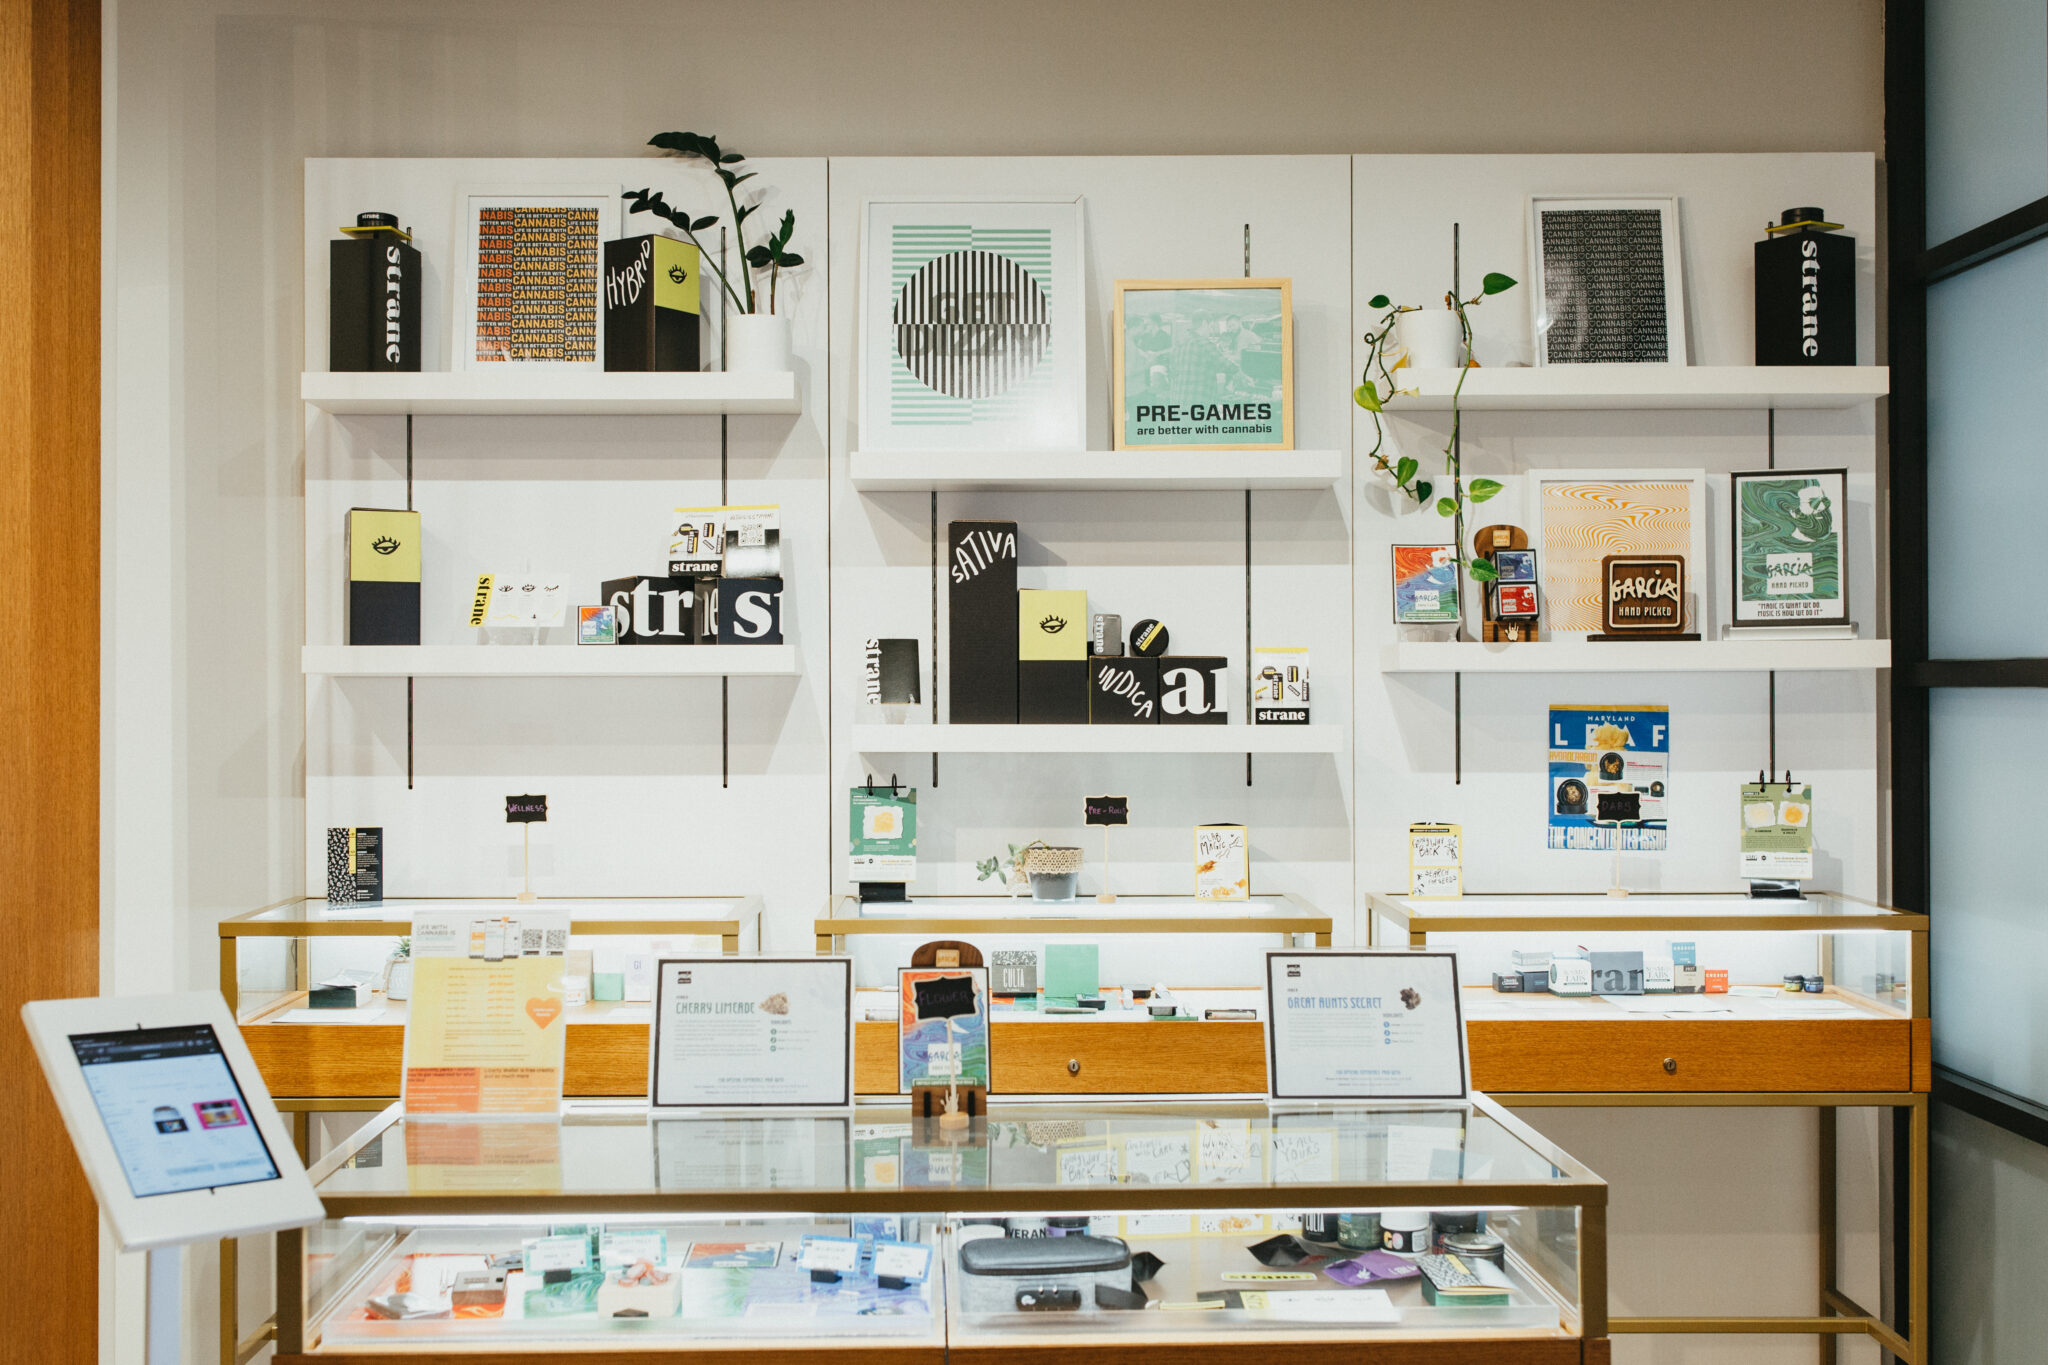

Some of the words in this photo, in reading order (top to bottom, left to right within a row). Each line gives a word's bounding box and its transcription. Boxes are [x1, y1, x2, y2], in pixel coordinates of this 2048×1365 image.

[514, 219, 566, 227] CANNABIS
[514, 233, 566, 242] CANNABIS
[513, 248, 566, 256] CANNABIS
[513, 262, 565, 270] CANNABIS
[513, 276, 565, 285] CANNABIS
[606, 240, 650, 310] HYBRID
[512, 291, 565, 299] CANNABIS
[1802, 240, 1820, 356] strane
[386, 246, 402, 363] strane
[512, 305, 564, 314] CANNABIS
[932, 292, 1014, 324] GET
[512, 320, 564, 328] CANNABIS
[512, 334, 564, 342] CANNABIS
[511, 348, 563, 357] CANNABIS
[1137, 403, 1271, 422] PRE-GAMES
[1158, 425, 1192, 435] better
[1195, 425, 1218, 434] with
[1222, 424, 1272, 434] cannabis
[952, 530, 1016, 583] SATIVA
[672, 562, 718, 572] strane
[1767, 558, 1812, 578] GARCIA
[1613, 570, 1677, 602] GARCIA
[470, 577, 490, 625] strane
[1619, 607, 1640, 616] HAND
[1644, 607, 1671, 616] PICKED
[1096, 615, 1104, 653] strane
[1135, 623, 1155, 647] strane
[866, 638, 882, 704] strane
[1098, 665, 1153, 718] INDICA
[1259, 710, 1306, 720] strane
[508, 804, 544, 813] WELLNESS
[1602, 801, 1632, 812] DABS
[1549, 827, 1566, 848] THE
[1200, 841, 1225, 855] MAGIC
[1003, 968, 1024, 987] CULTA
[919, 991, 969, 1006] FLOWER
[1288, 997, 1316, 1008] GREAT
[1319, 997, 1348, 1008] AUNTS
[1351, 997, 1382, 1008] SECRET
[676, 1002, 712, 1014] CHERRY
[715, 1002, 755, 1014] LIMEADE
[1282, 1144, 1320, 1161] YOURS
